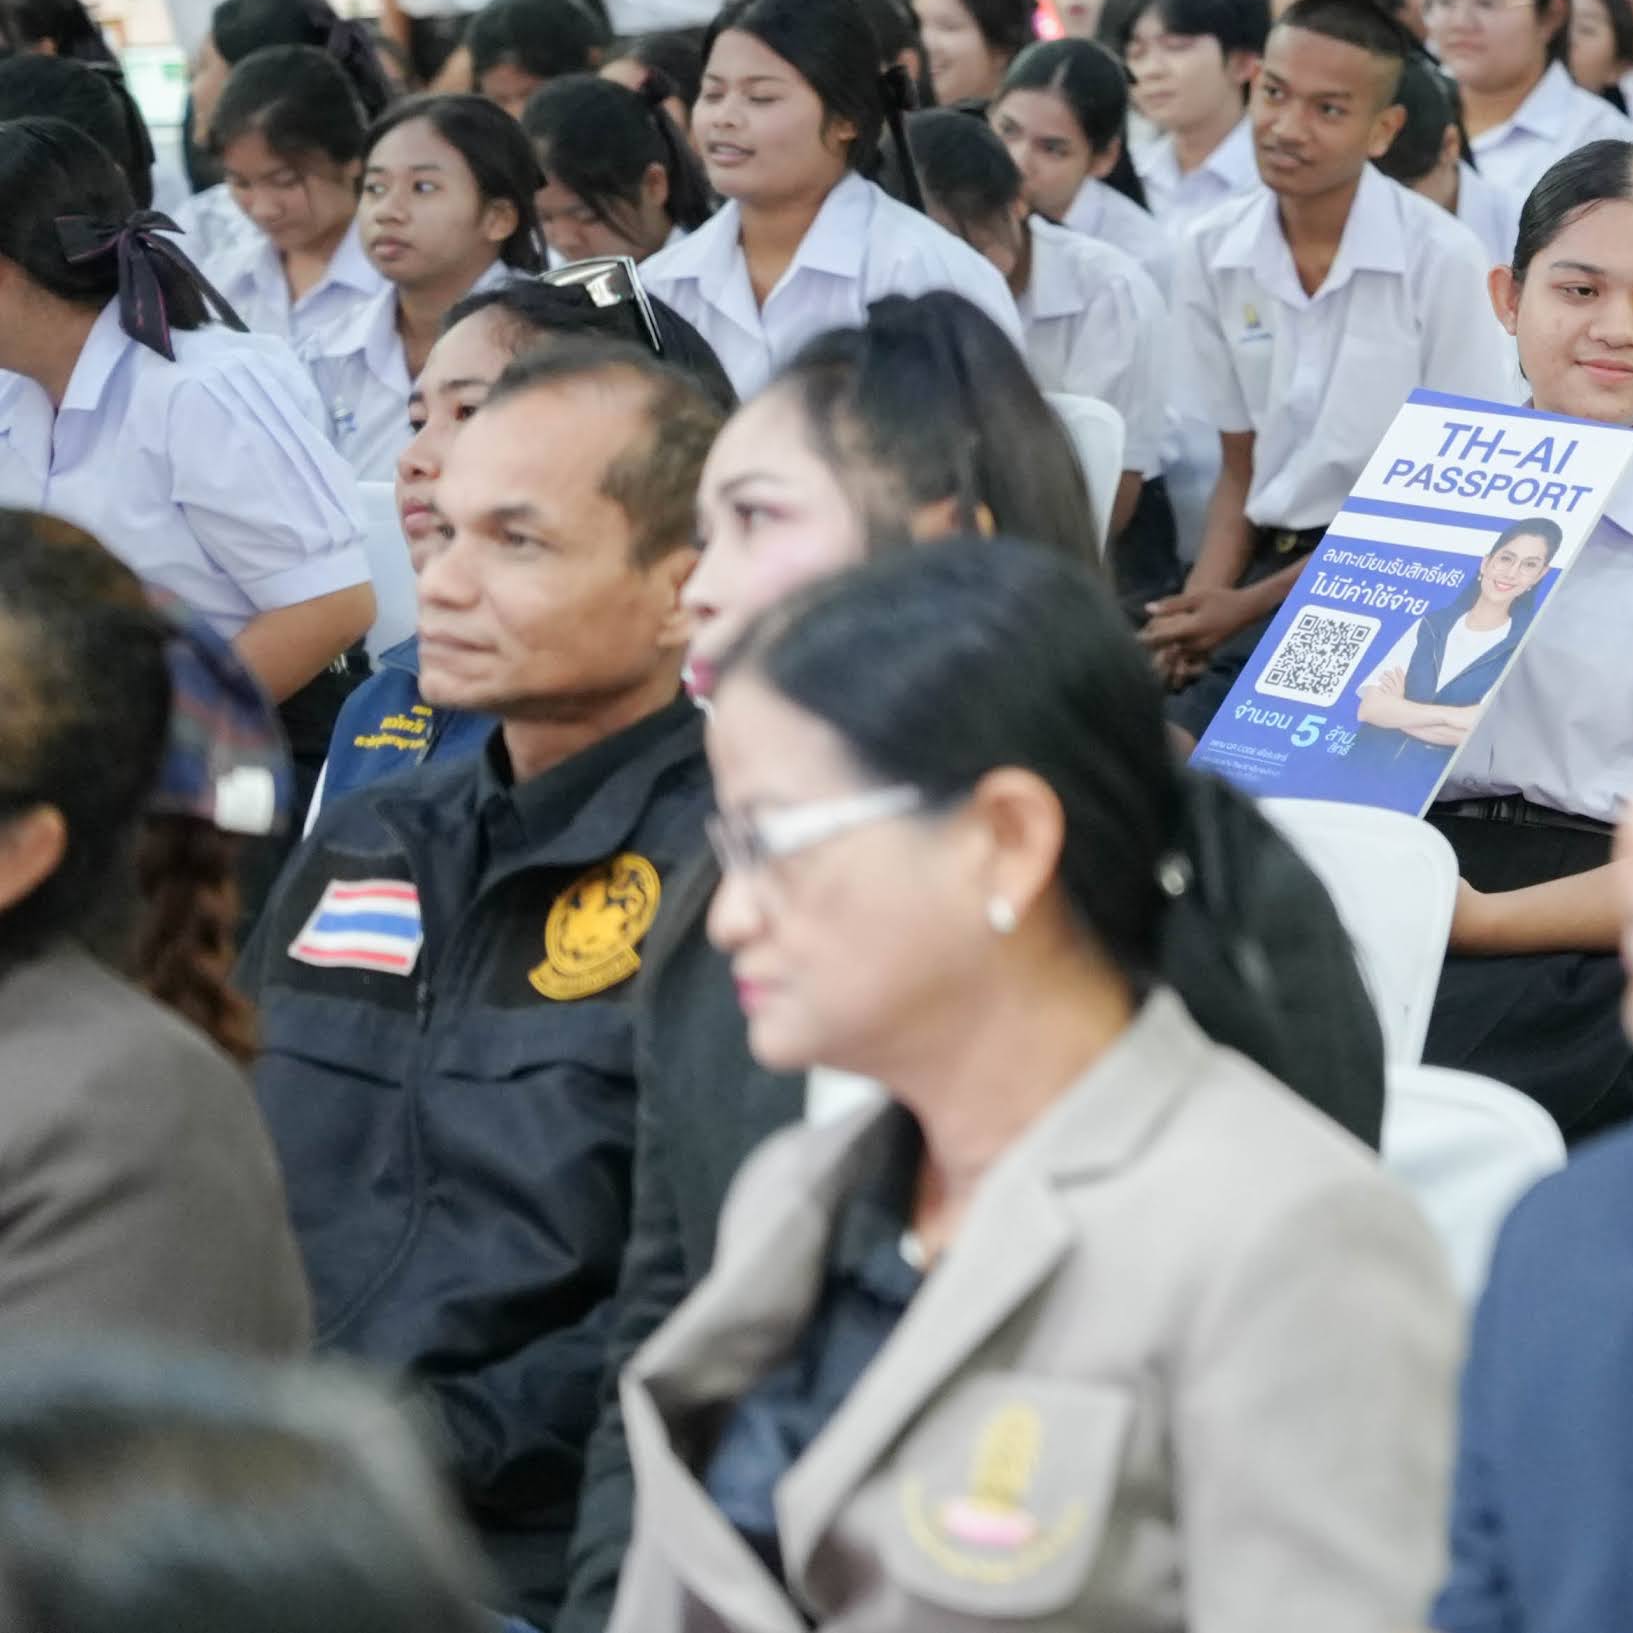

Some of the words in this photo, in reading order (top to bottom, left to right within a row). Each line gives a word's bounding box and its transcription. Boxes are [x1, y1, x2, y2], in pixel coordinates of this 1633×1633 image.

[1437, 421, 1579, 474] TH-AI
[1382, 458, 1593, 512] PASSPORT
[1310, 571, 1430, 616] ไม่มีค่าใช้จ่าย
[1234, 699, 1294, 731] จำนวน
[1290, 713, 1328, 747] 5
